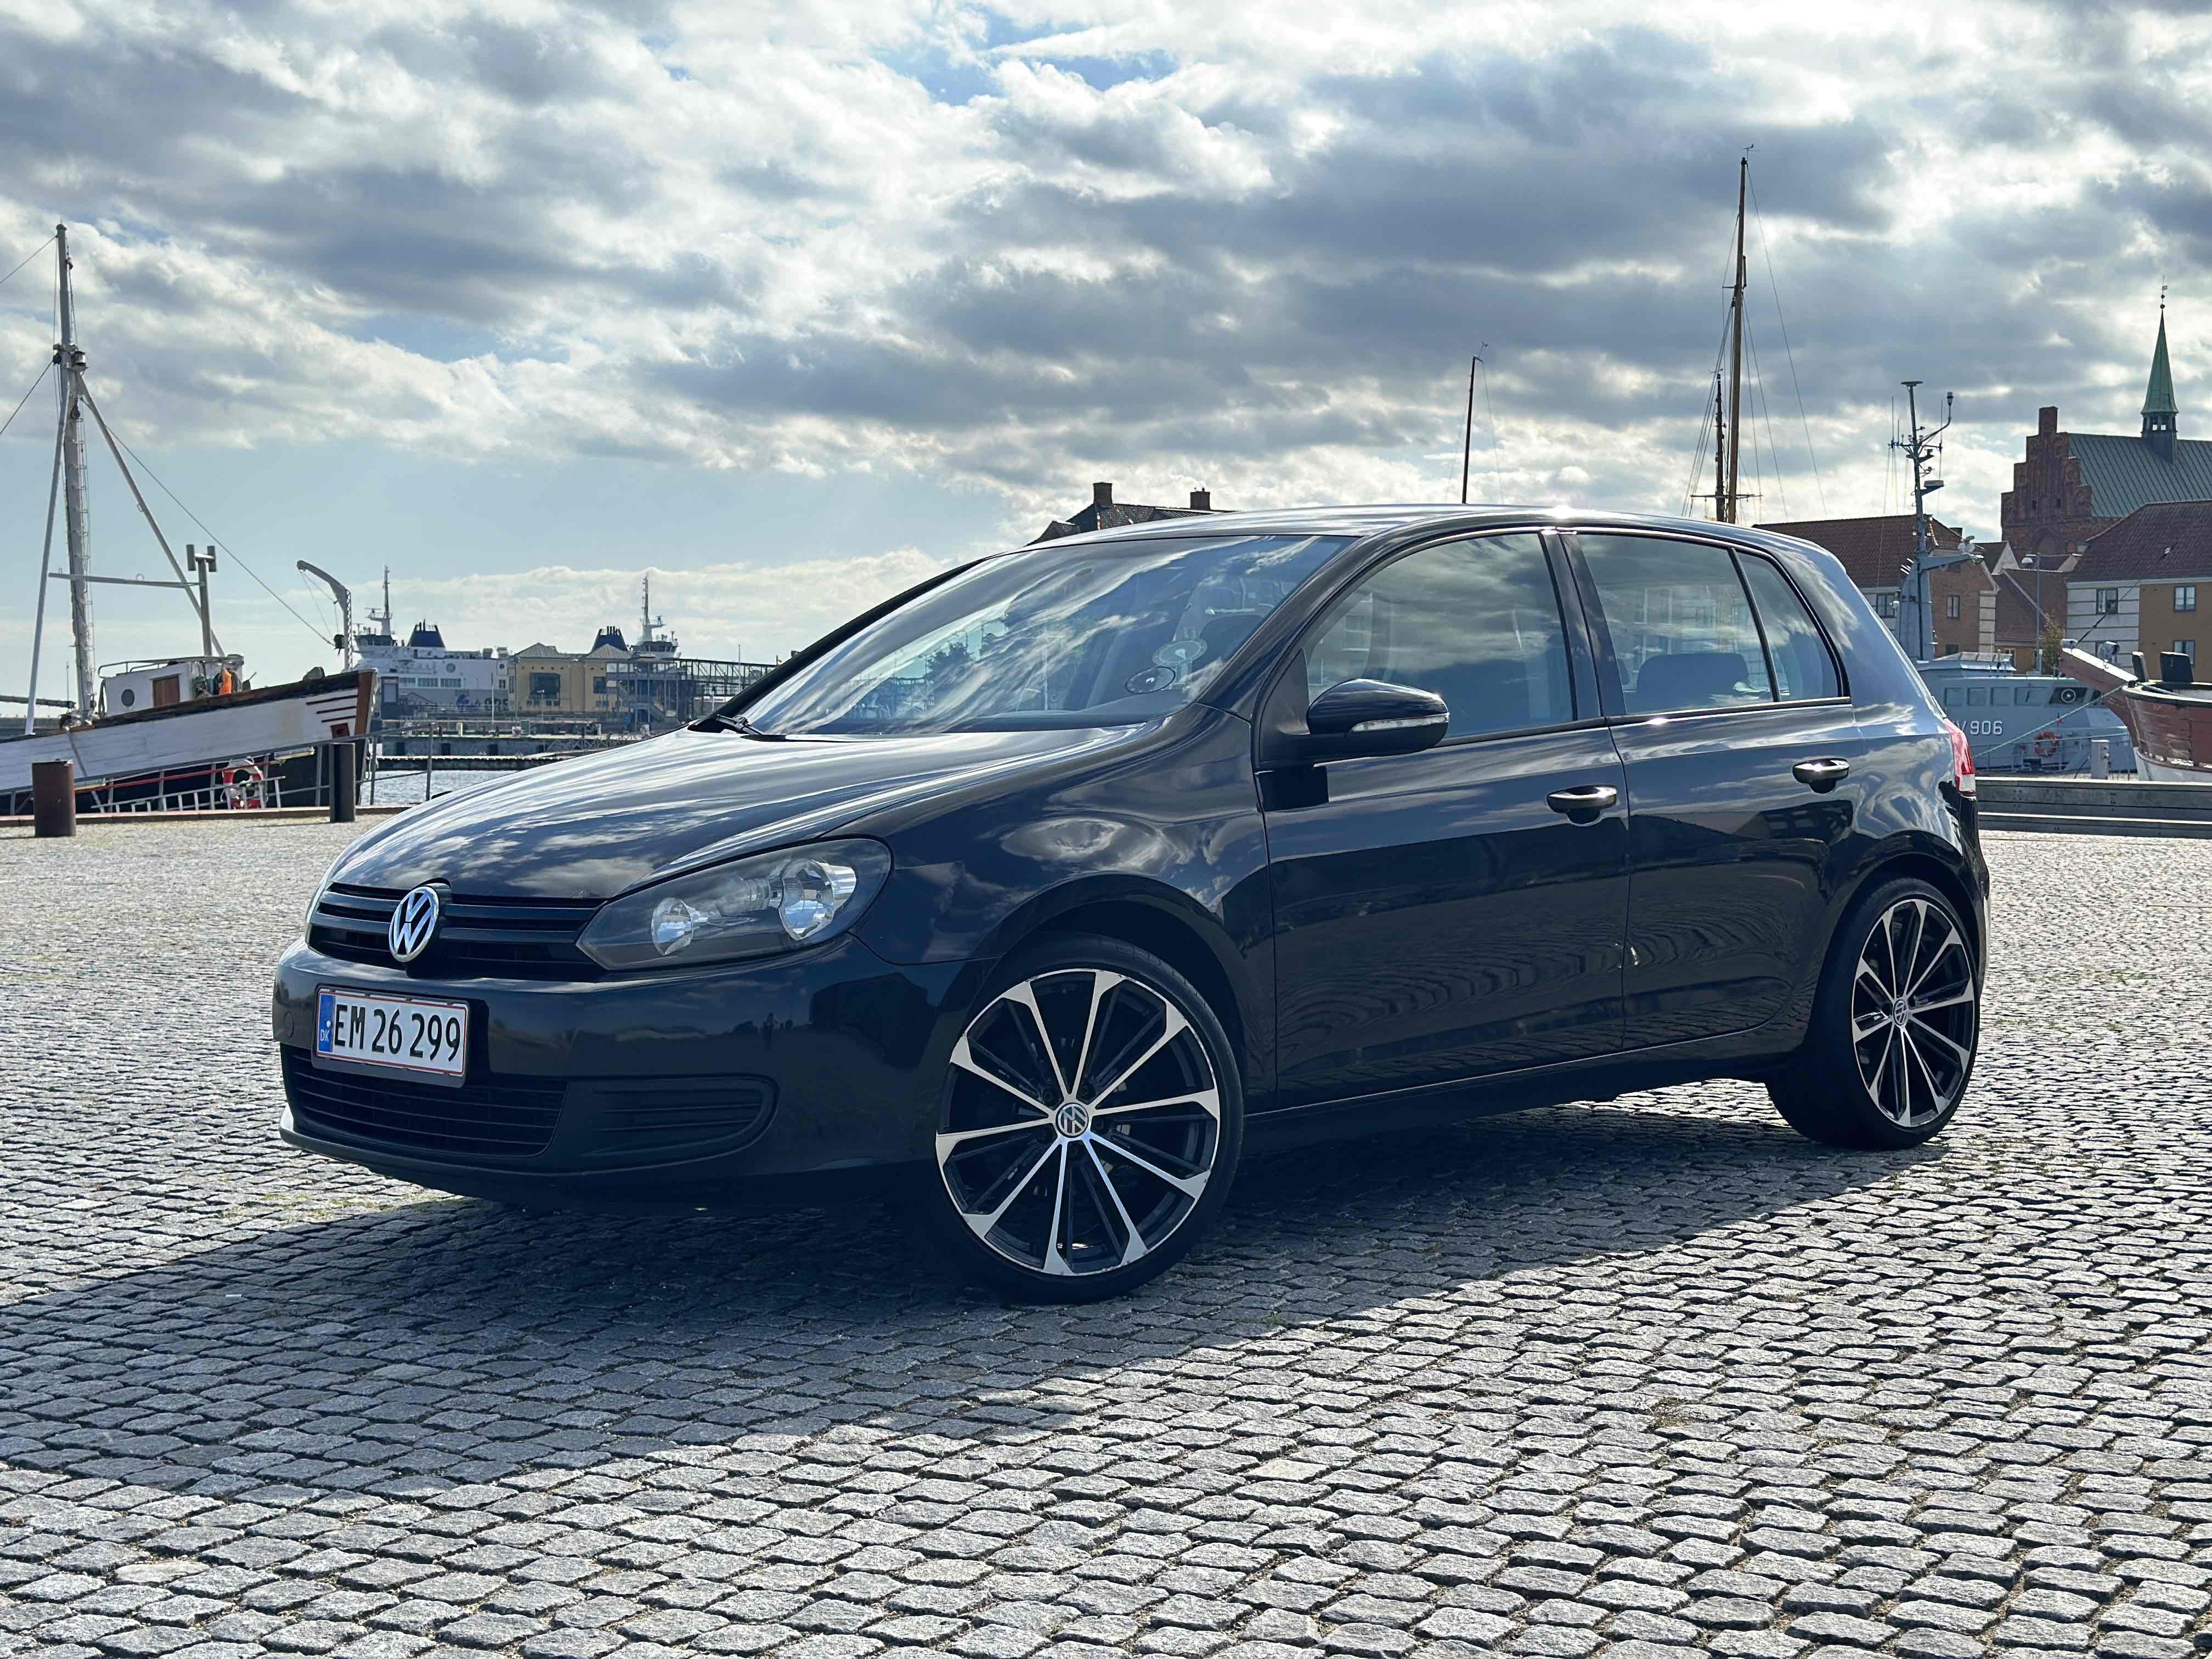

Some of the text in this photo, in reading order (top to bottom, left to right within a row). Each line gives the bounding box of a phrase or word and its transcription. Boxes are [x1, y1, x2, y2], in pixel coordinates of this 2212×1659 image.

[1970, 720, 2002, 735] 906
[389, 887, 438, 962] VW
[320, 1029, 330, 1042] DK
[334, 1004, 460, 1062] EM 26 299
